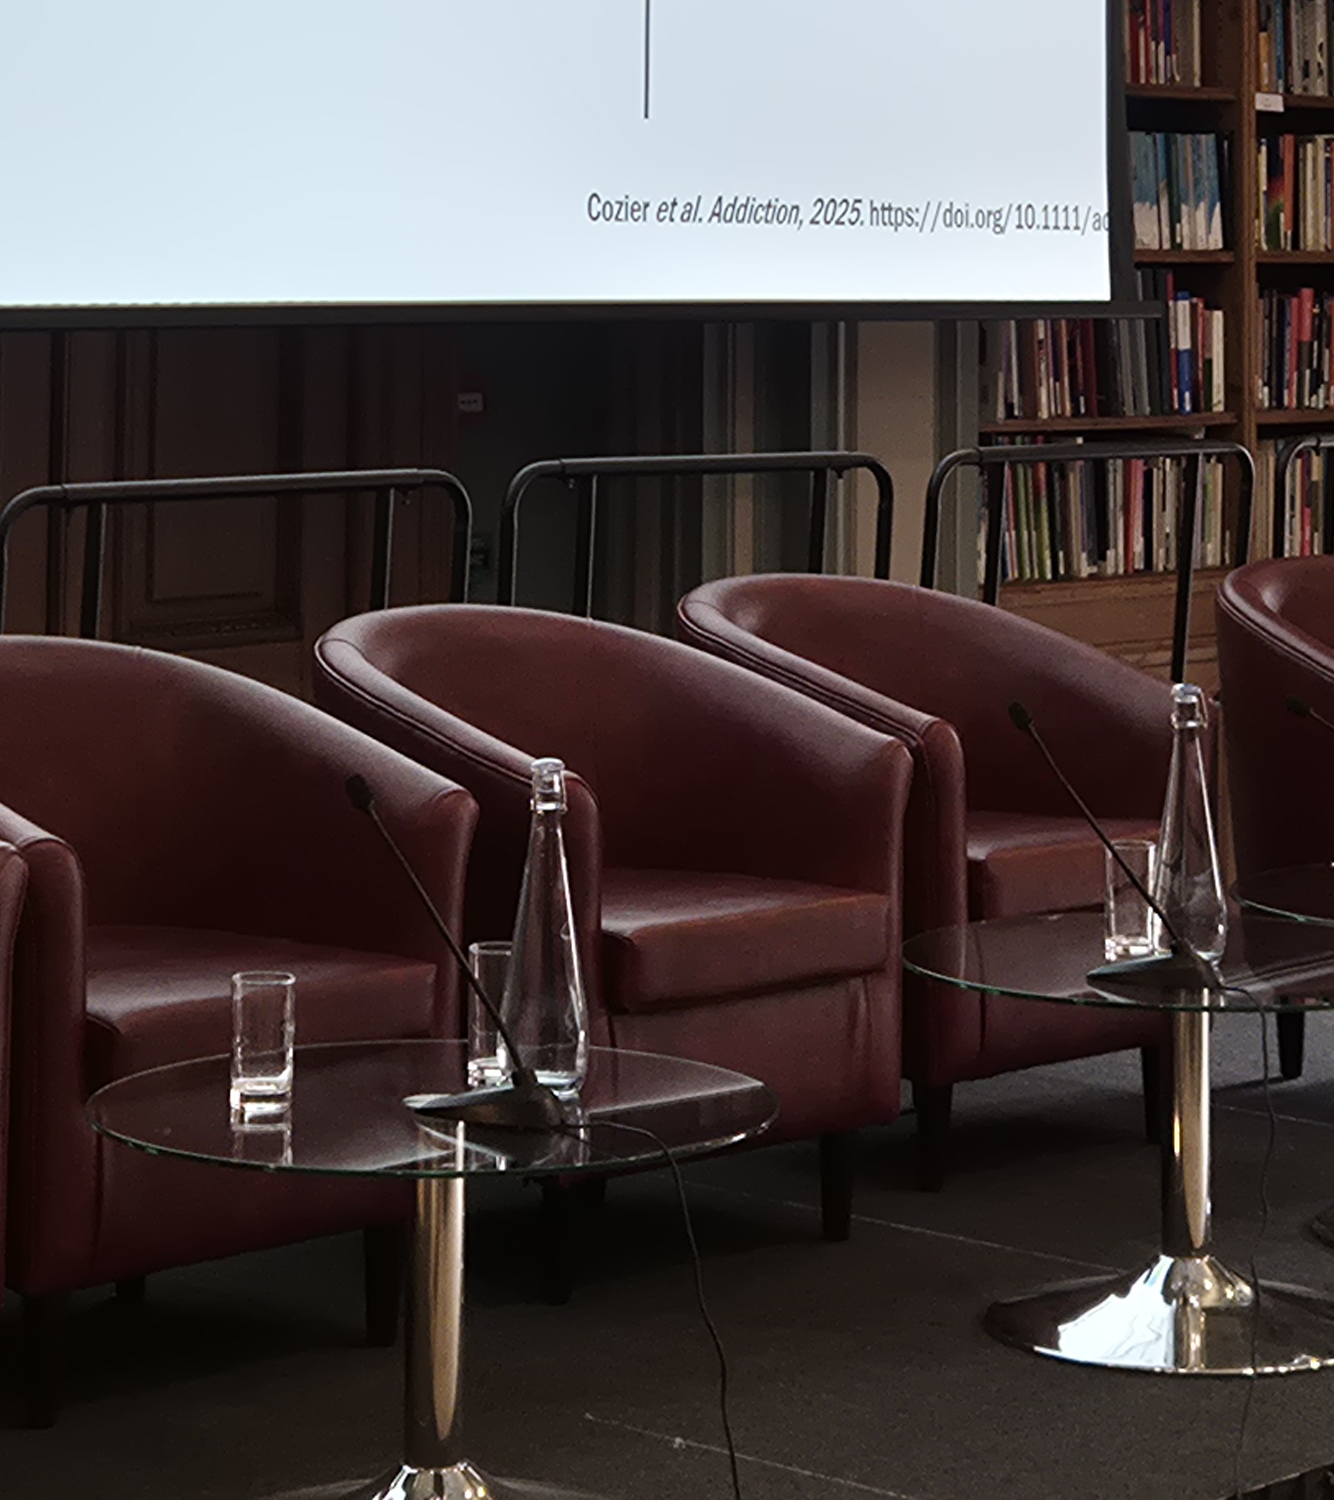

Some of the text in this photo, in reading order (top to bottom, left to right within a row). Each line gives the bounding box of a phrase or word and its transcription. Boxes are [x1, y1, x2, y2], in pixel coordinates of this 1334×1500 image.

[586, 192, 651, 223] Cozier
[656, 195, 679, 223] et
[680, 196, 704, 224] al.
[708, 195, 804, 231] Addiction,
[810, 199, 865, 227] 2025.
